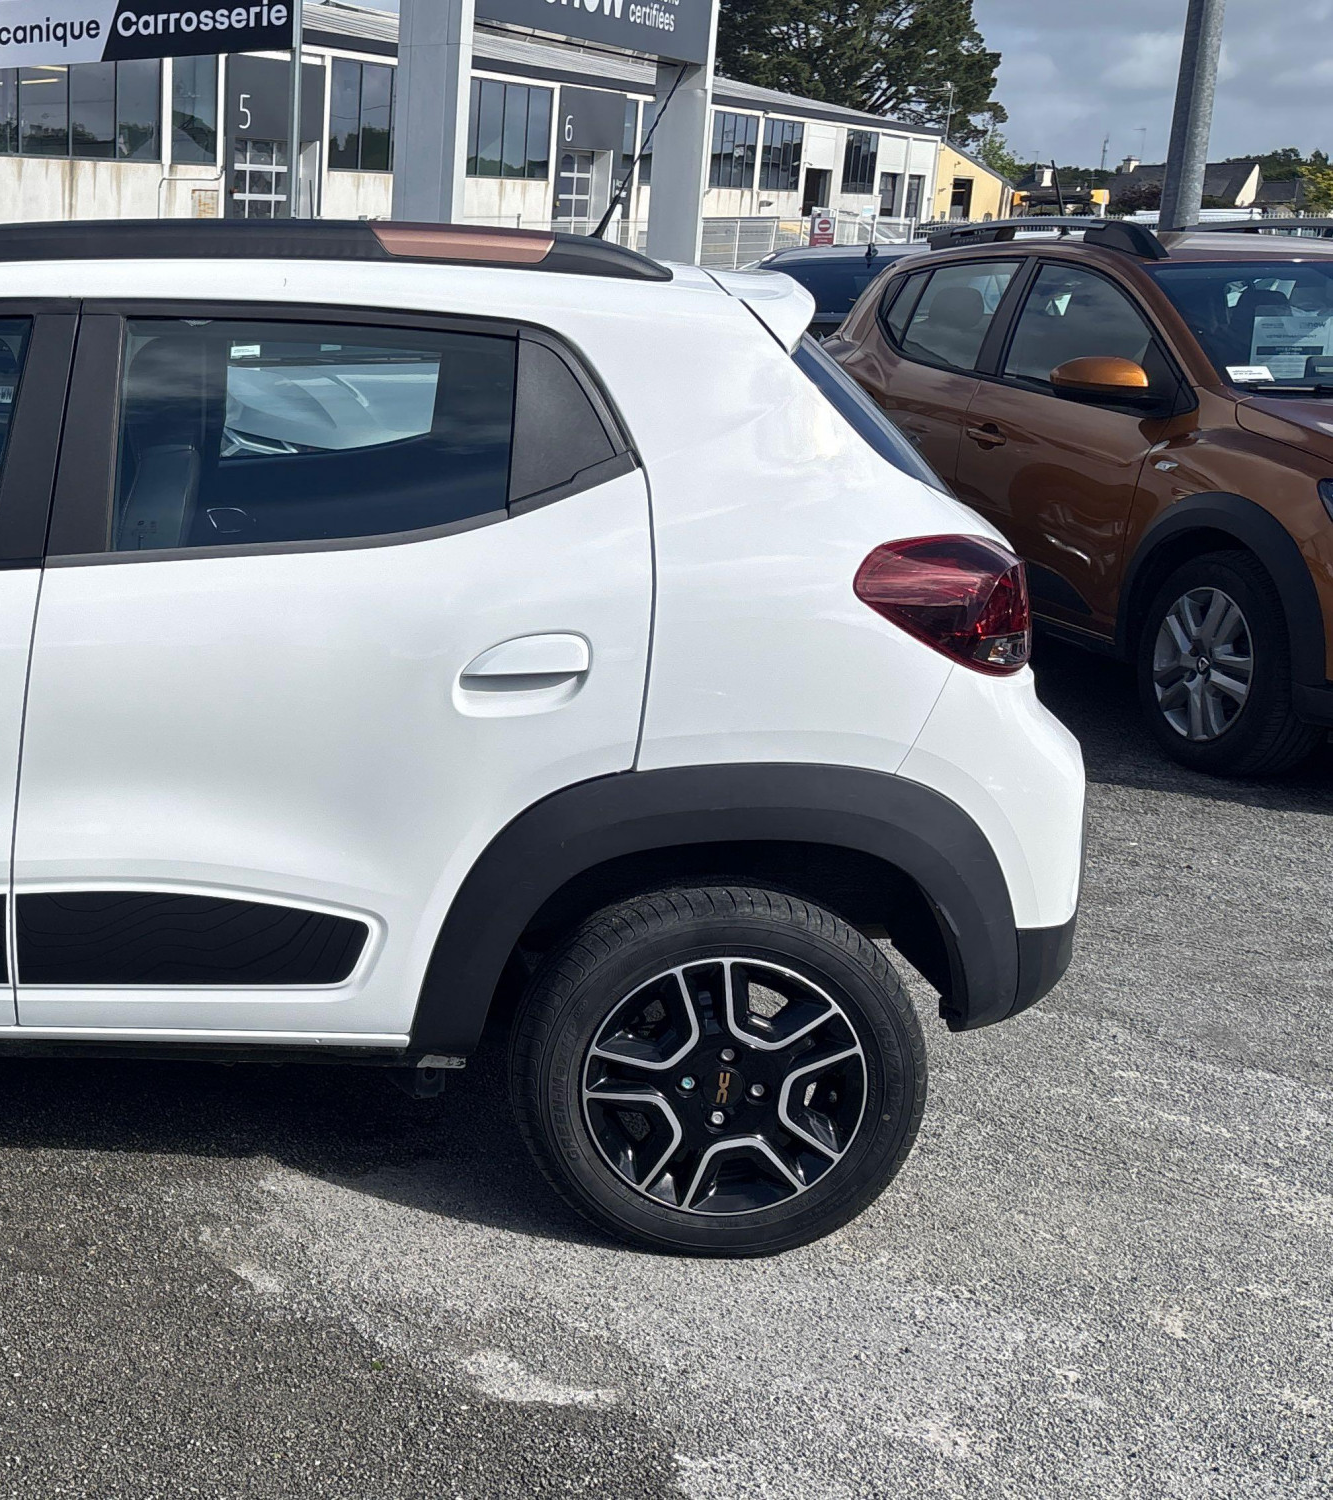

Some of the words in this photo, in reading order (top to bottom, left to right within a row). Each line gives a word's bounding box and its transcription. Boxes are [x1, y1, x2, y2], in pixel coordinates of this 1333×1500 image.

[117, 0, 288, 37] Carrosserie
[629, 3, 675, 32] certifiées
[238, 94, 252, 129] 5
[564, 115, 574, 142] 6
